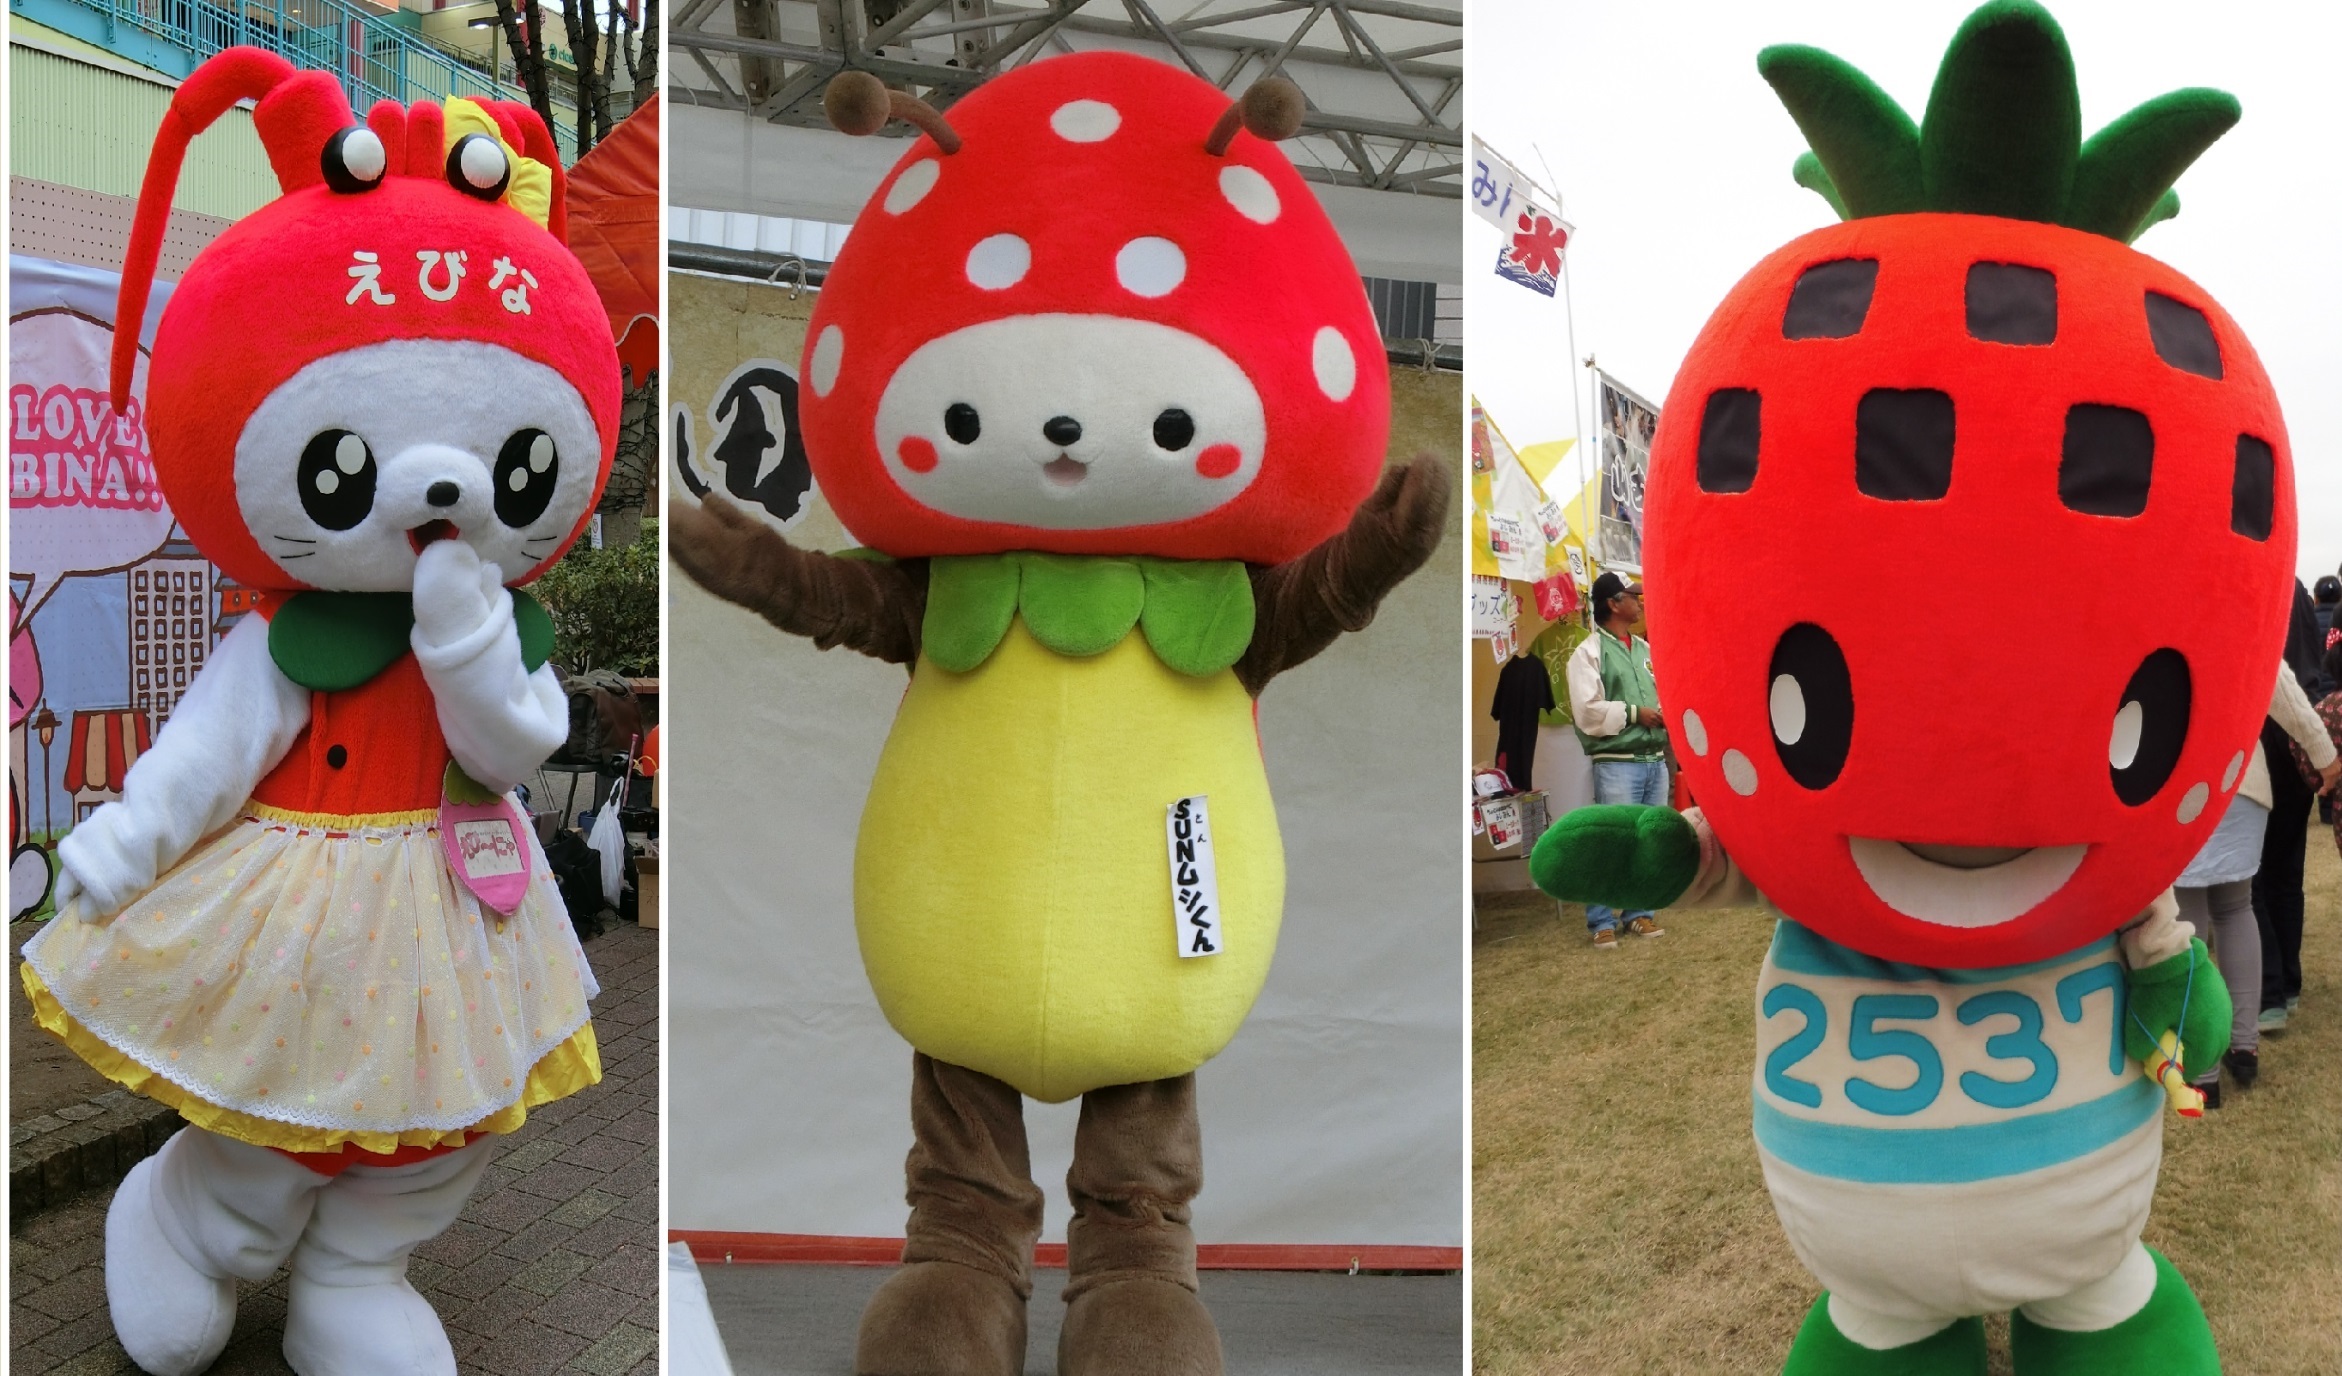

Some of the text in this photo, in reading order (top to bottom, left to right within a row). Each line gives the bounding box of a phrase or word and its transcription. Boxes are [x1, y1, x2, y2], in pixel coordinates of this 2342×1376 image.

[1509, 211, 1567, 278] 氷
[346, 250, 539, 315] えびな
[14, 394, 137, 447] LOVE
[1763, 961, 2125, 1116] 2537
